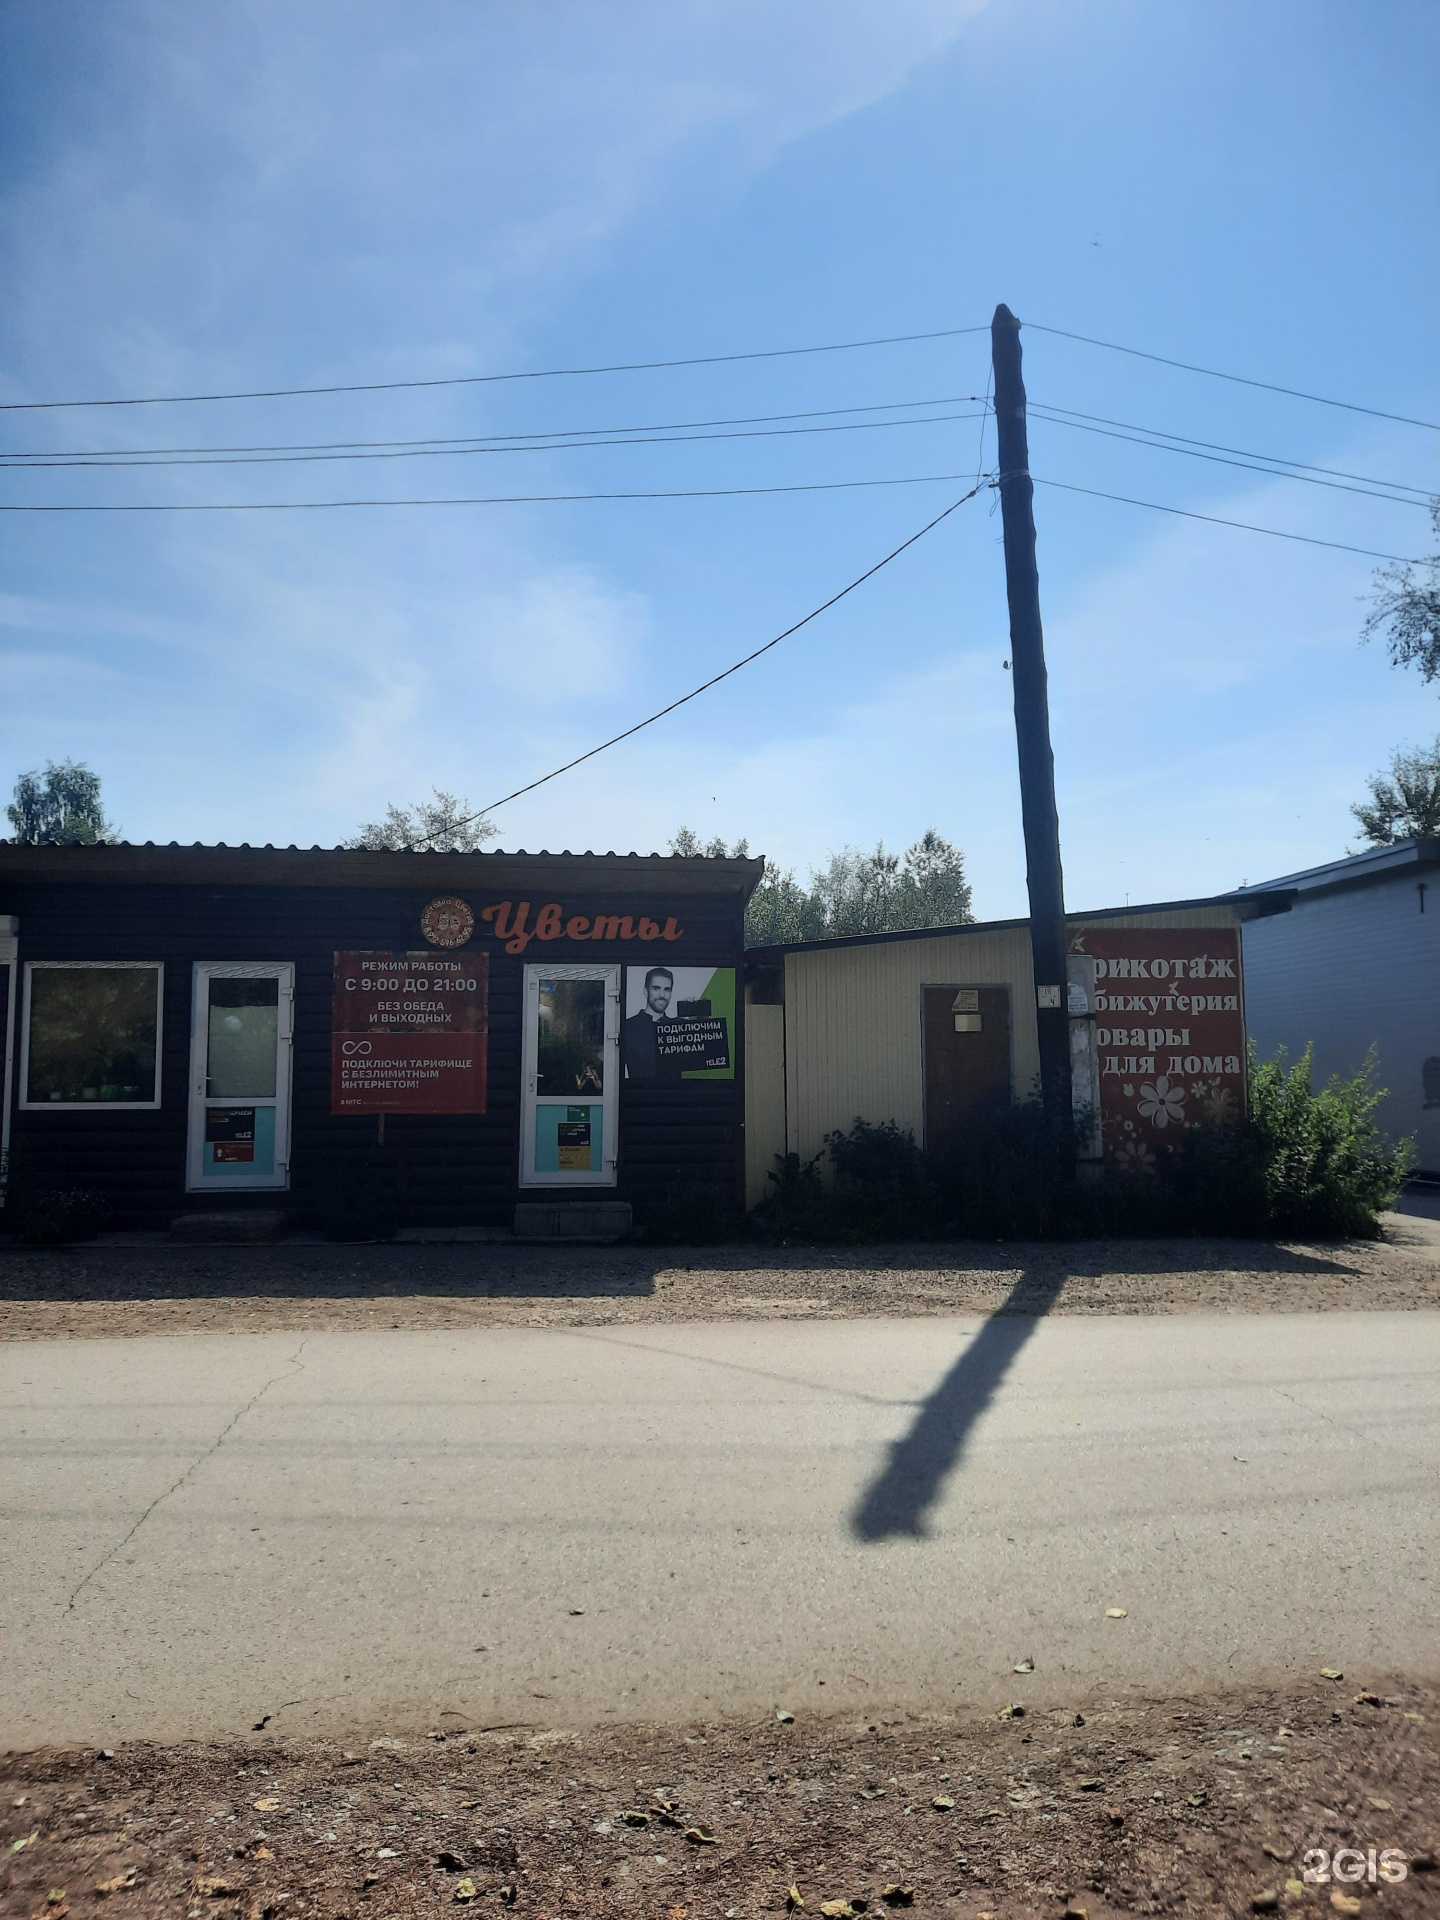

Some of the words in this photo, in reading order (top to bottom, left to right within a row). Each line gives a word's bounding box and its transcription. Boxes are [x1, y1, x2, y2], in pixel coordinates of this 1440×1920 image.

[481, 901, 684, 954] Цветы
[362, 961, 409, 971] РЕЖИМ
[411, 961, 461, 971] РАБОТЫ
[1093, 957, 1237, 984] рикотаж
[344, 978, 356, 991] С
[361, 978, 399, 991] 9:00
[403, 978, 429, 993] ДО
[433, 978, 477, 991] 21:00
[377, 1001, 400, 1011] БЕЗ
[403, 1001, 445, 1012] ОБЕДА
[1093, 989, 1239, 1016] бижутерия
[369, 1013, 378, 1023] И
[381, 1013, 452, 1024] ВЫХОДНЫХ
[657, 1022, 721, 1034] ПОДКЛЮЧИМ
[657, 1036, 664, 1044] К
[666, 1032, 723, 1043] ВЫГОДНЫМ
[1097, 1027, 1192, 1051] овары
[658, 1044, 705, 1055] ТАРИФАМ
[341, 1059, 407, 1070] ПОДКЛЮЧИ
[410, 1059, 473, 1070] ТАРИФИЩЕ
[705, 1057, 727, 1067] TELE2
[1102, 1055, 1156, 1077] для
[1166, 1055, 1240, 1077] дома
[341, 1070, 349, 1079] С
[351, 1070, 439, 1079] БЕЗЛИМИТНЫМ
[341, 1080, 419, 1089] ИНТЕРНЕТОМ!
